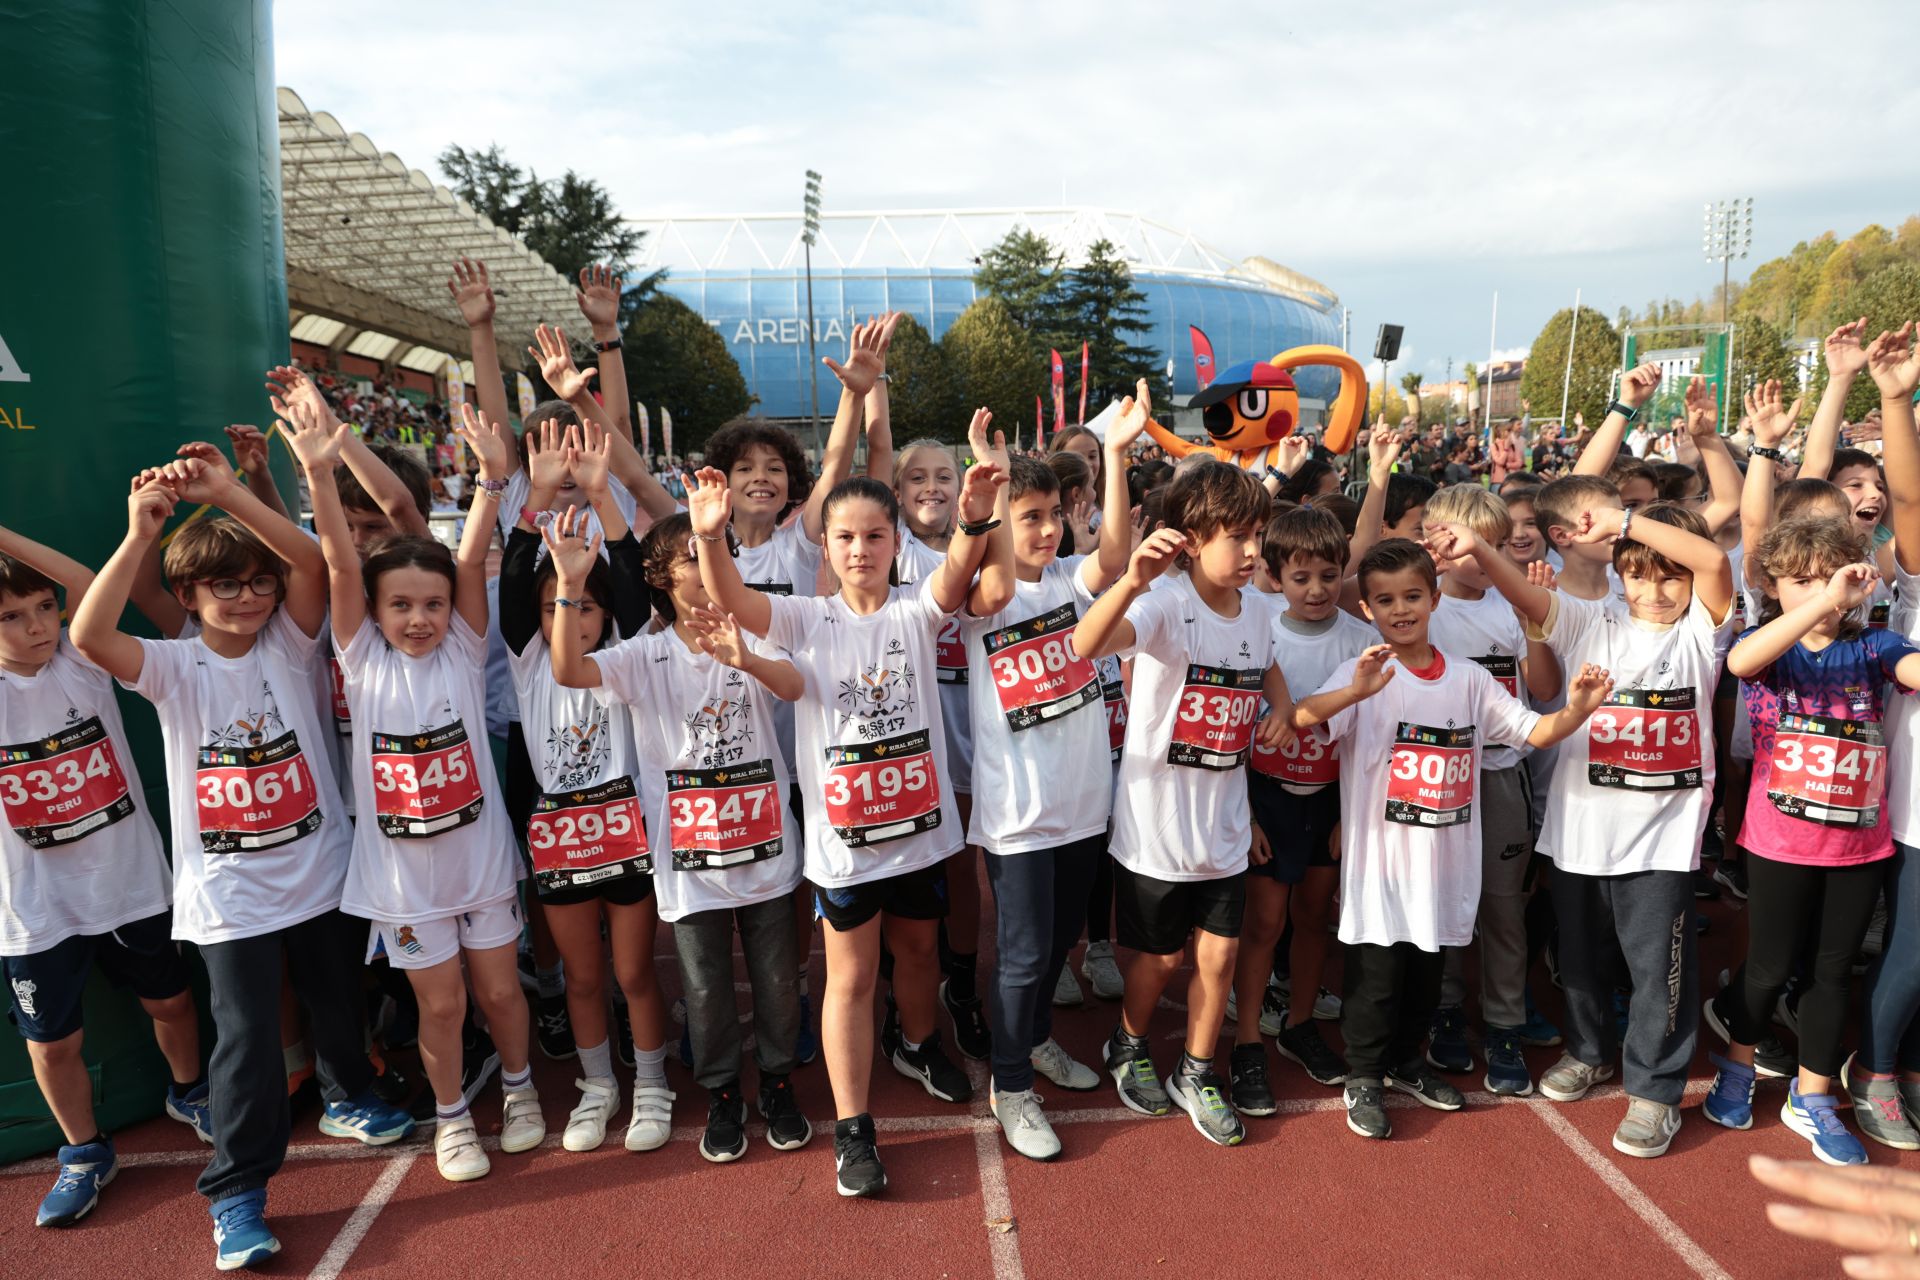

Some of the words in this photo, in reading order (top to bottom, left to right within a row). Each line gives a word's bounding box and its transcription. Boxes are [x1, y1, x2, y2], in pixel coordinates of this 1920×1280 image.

[733, 319, 846, 344] ARENA
[1034, 675, 1067, 693] UNAX
[1179, 692, 1254, 728] 3390
[886, 716, 906, 733] 17
[1591, 713, 1692, 747] 3413
[725, 746, 744, 762] 17
[1624, 750, 1663, 762] LUCAS
[1774, 740, 1877, 781] 3347
[0, 747, 111, 806] 3334
[374, 748, 468, 794] 3345
[585, 764, 601, 781] 17
[1287, 763, 1313, 774] OIER
[1393, 750, 1471, 785] 3068
[199, 761, 303, 808] 3061
[827, 759, 927, 806] 3195
[1805, 780, 1853, 796] HAIZEA
[46, 796, 82, 815] PERU
[410, 795, 441, 808] ALEX
[671, 788, 768, 829] 3247
[864, 801, 897, 815] UXUE
[243, 809, 273, 822] IBAI
[530, 803, 632, 850] 3295
[695, 826, 748, 841] ERLANTZ
[566, 844, 605, 860] MADDI
